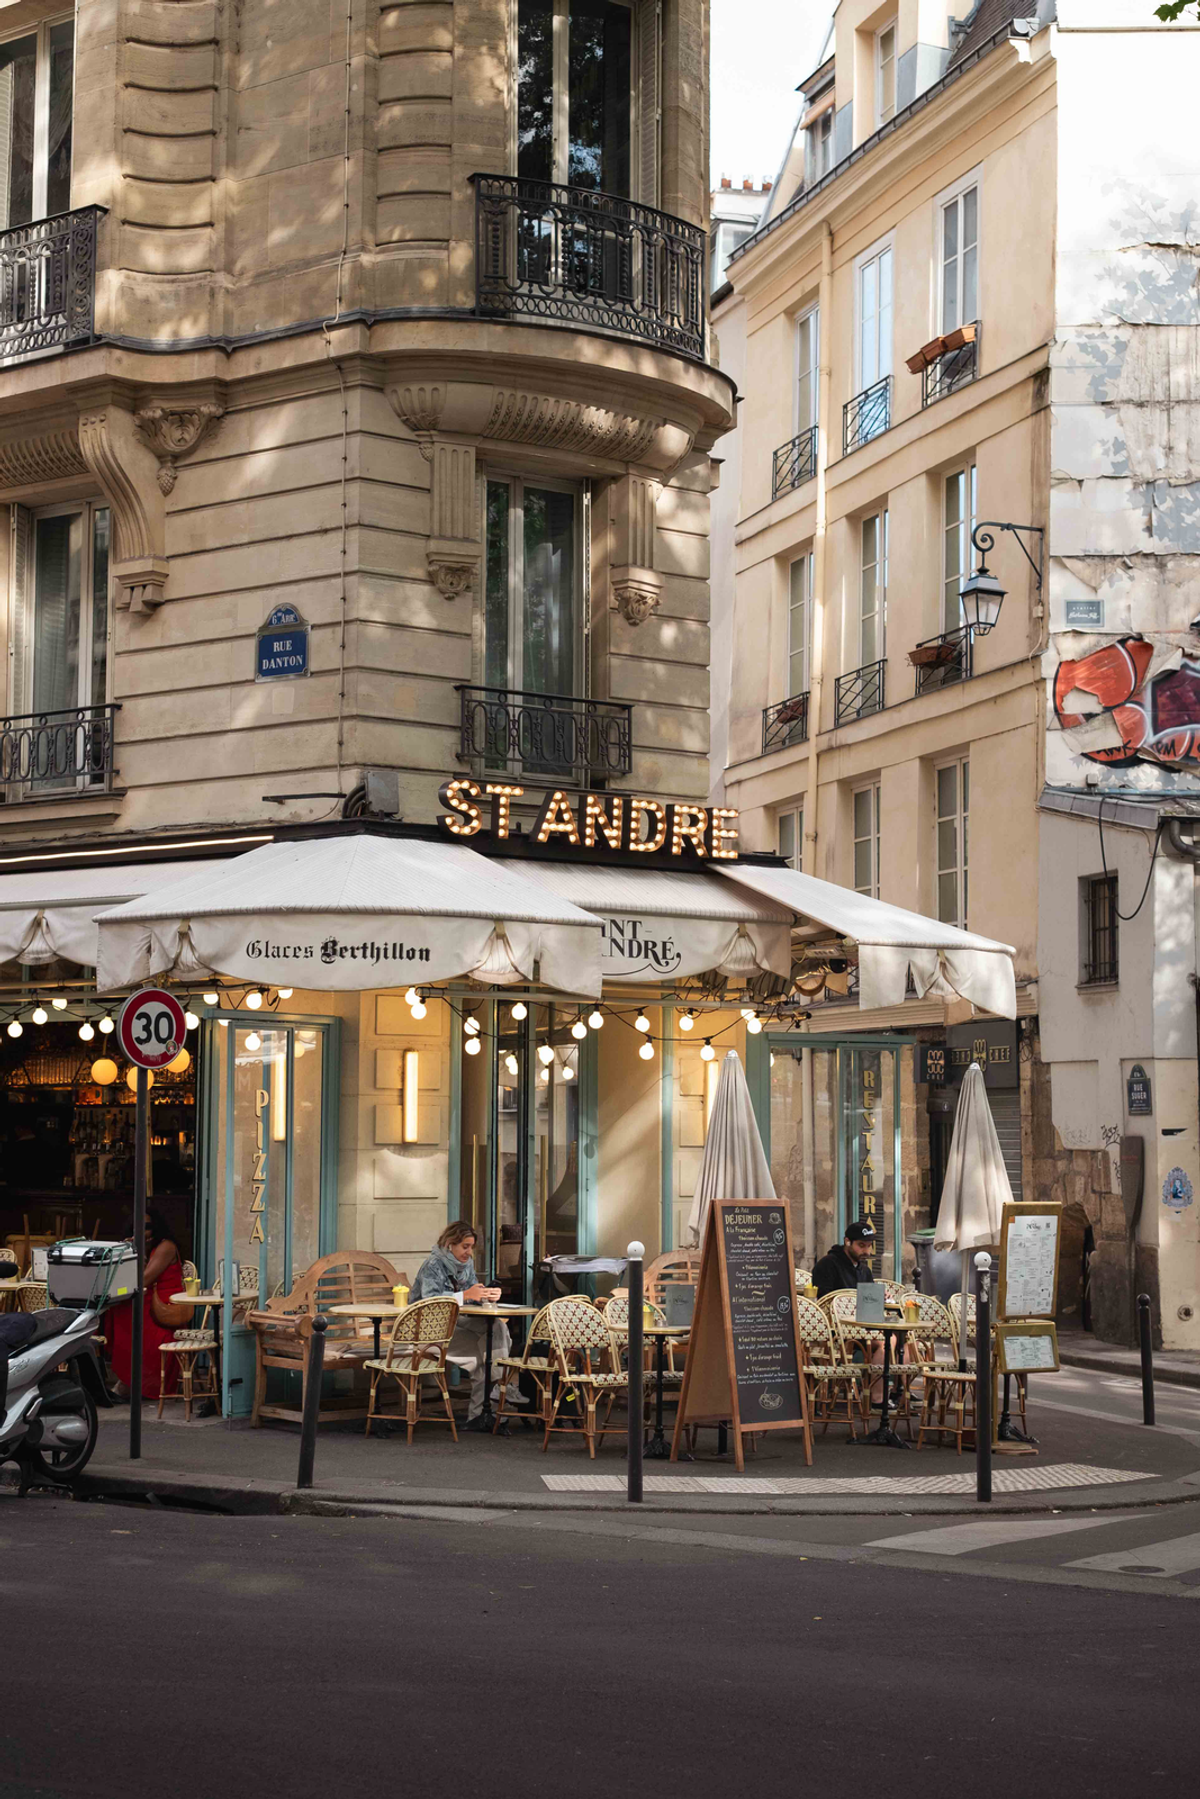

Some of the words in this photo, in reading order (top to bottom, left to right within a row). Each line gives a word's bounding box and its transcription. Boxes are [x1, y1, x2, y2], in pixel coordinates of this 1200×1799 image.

[273, 640, 293, 653] RUE
[262, 655, 303, 670] DANTON
[437, 779, 524, 840] ST
[530, 790, 738, 859] ANDRE
[246, 940, 314, 959] Glaces
[320, 936, 431, 967] Berthillon
[602, 936, 675, 967] NDRÉ
[134, 1011, 175, 1045] 30
[989, 1049, 1010, 1061] CHEF
[1133, 1083, 1143, 1091] RUE
[249, 1089, 269, 1245] PIZZA
